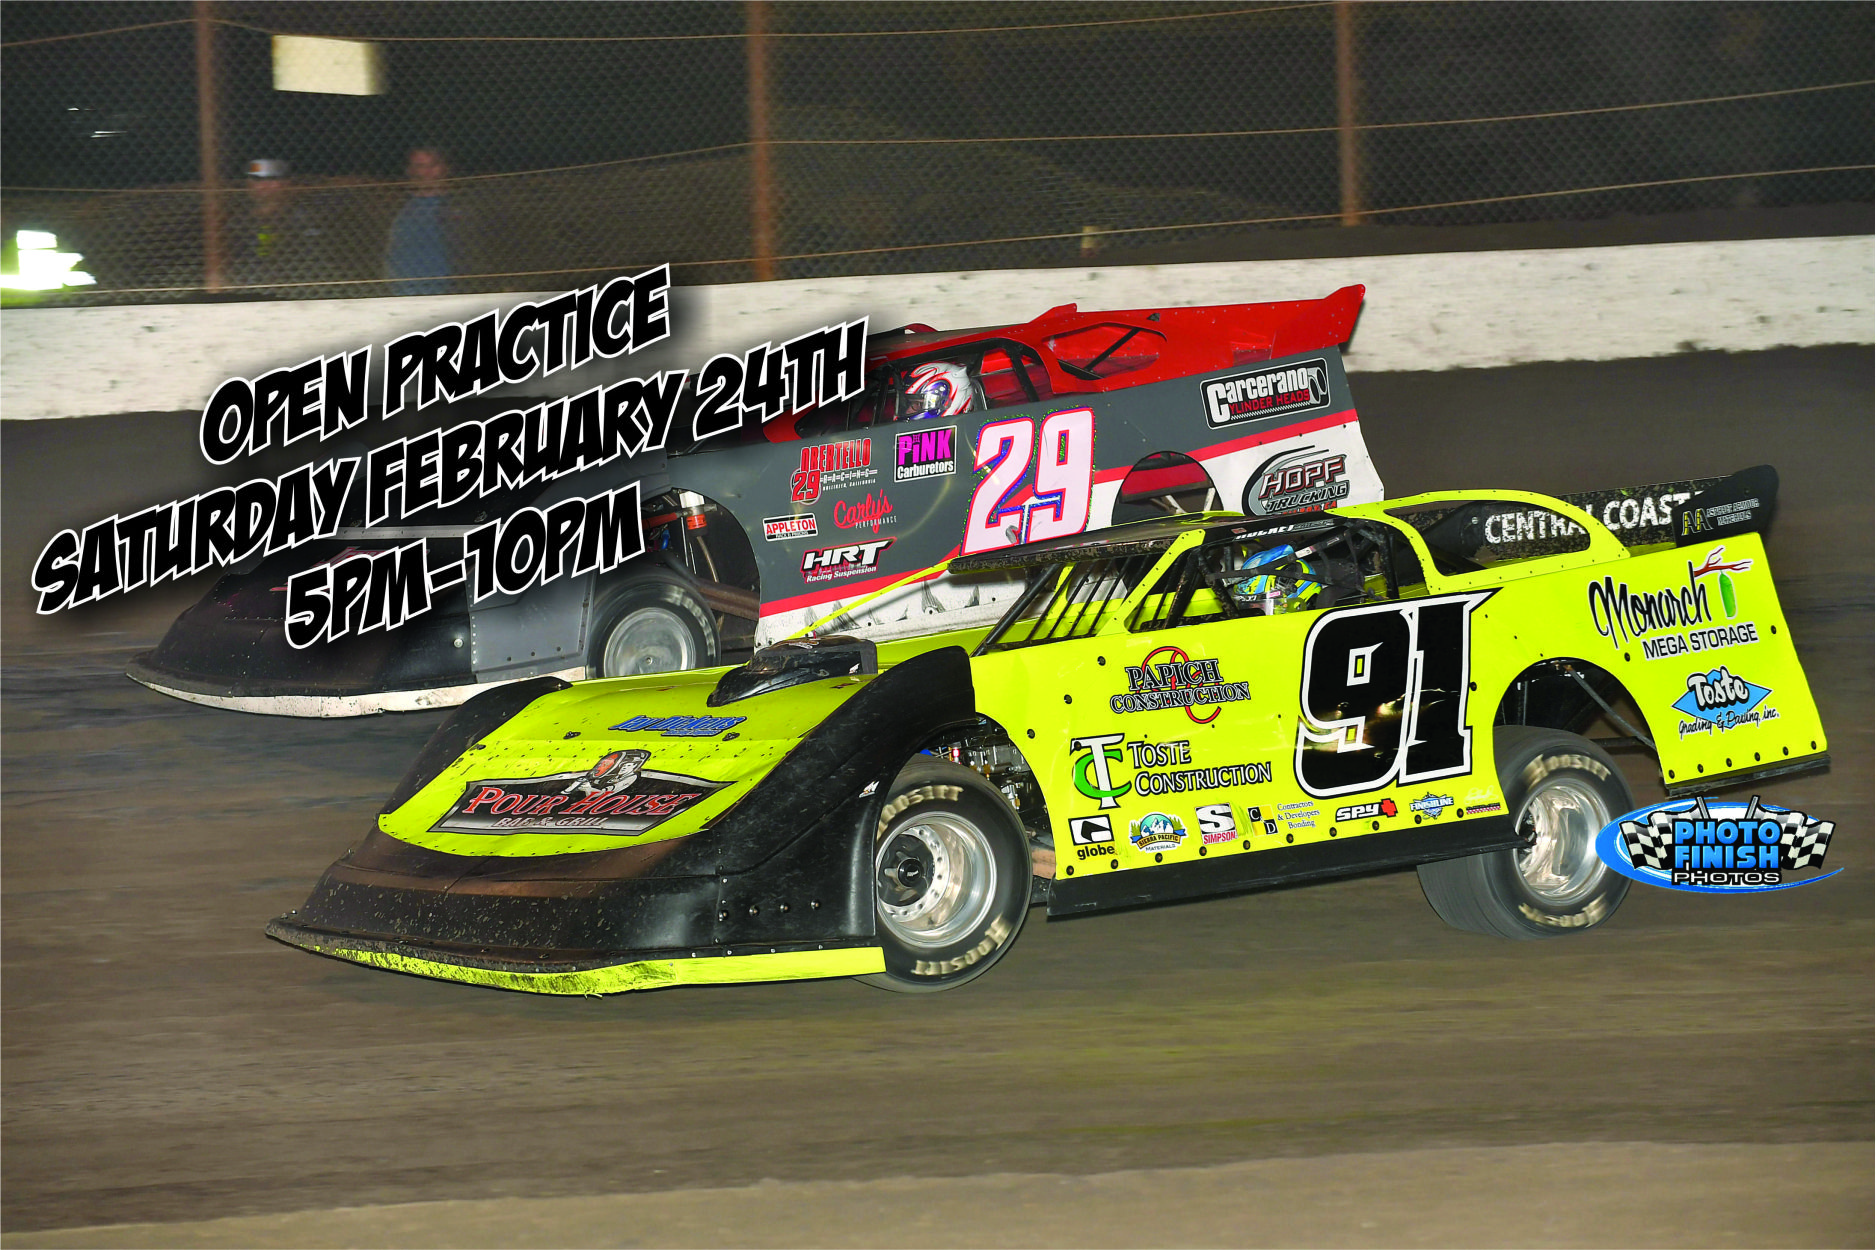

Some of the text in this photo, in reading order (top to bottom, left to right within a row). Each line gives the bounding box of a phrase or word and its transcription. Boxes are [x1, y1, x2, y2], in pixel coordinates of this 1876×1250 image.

[1206, 367, 1309, 424] Carcerano
[1275, 388, 1311, 405] HEADS
[800, 438, 871, 473] OBERTELLO
[896, 461, 955, 480] Carburetors
[960, 407, 1097, 556] 29
[1258, 455, 1347, 499] HOPF
[791, 469, 821, 503] 29
[1264, 481, 1349, 513] TRUCKING
[833, 488, 894, 534] Carly's
[855, 515, 898, 529] PERFORMANCE
[766, 518, 817, 535] APPLETON
[802, 539, 893, 573] HRT
[806, 572, 833, 583] Racing
[833, 566, 877, 581] Suspension
[1588, 560, 1712, 650] Monarch
[1642, 622, 1759, 661] MEGA STORAGE
[1125, 658, 1224, 691] PAPICH
[1109, 682, 1251, 714] CONSTRUCTION
[1293, 587, 1504, 800] 91
[1687, 665, 1750, 712] Toste
[1715, 711, 1725, 733] &
[462, 786, 703, 815] POUR HOUSE
[1277, 800, 1314, 811] Contractors
[1336, 803, 1380, 822] SPY
[554, 816, 609, 828] GRILL
[1285, 809, 1320, 822] Developers
[1288, 818, 1315, 830] Bonding
[1138, 832, 1180, 848] SIERRA PACIFIC
[1144, 843, 1176, 852] MATERIALS
[1203, 832, 1237, 844] SIMPSON
[1077, 843, 1115, 860] globe
